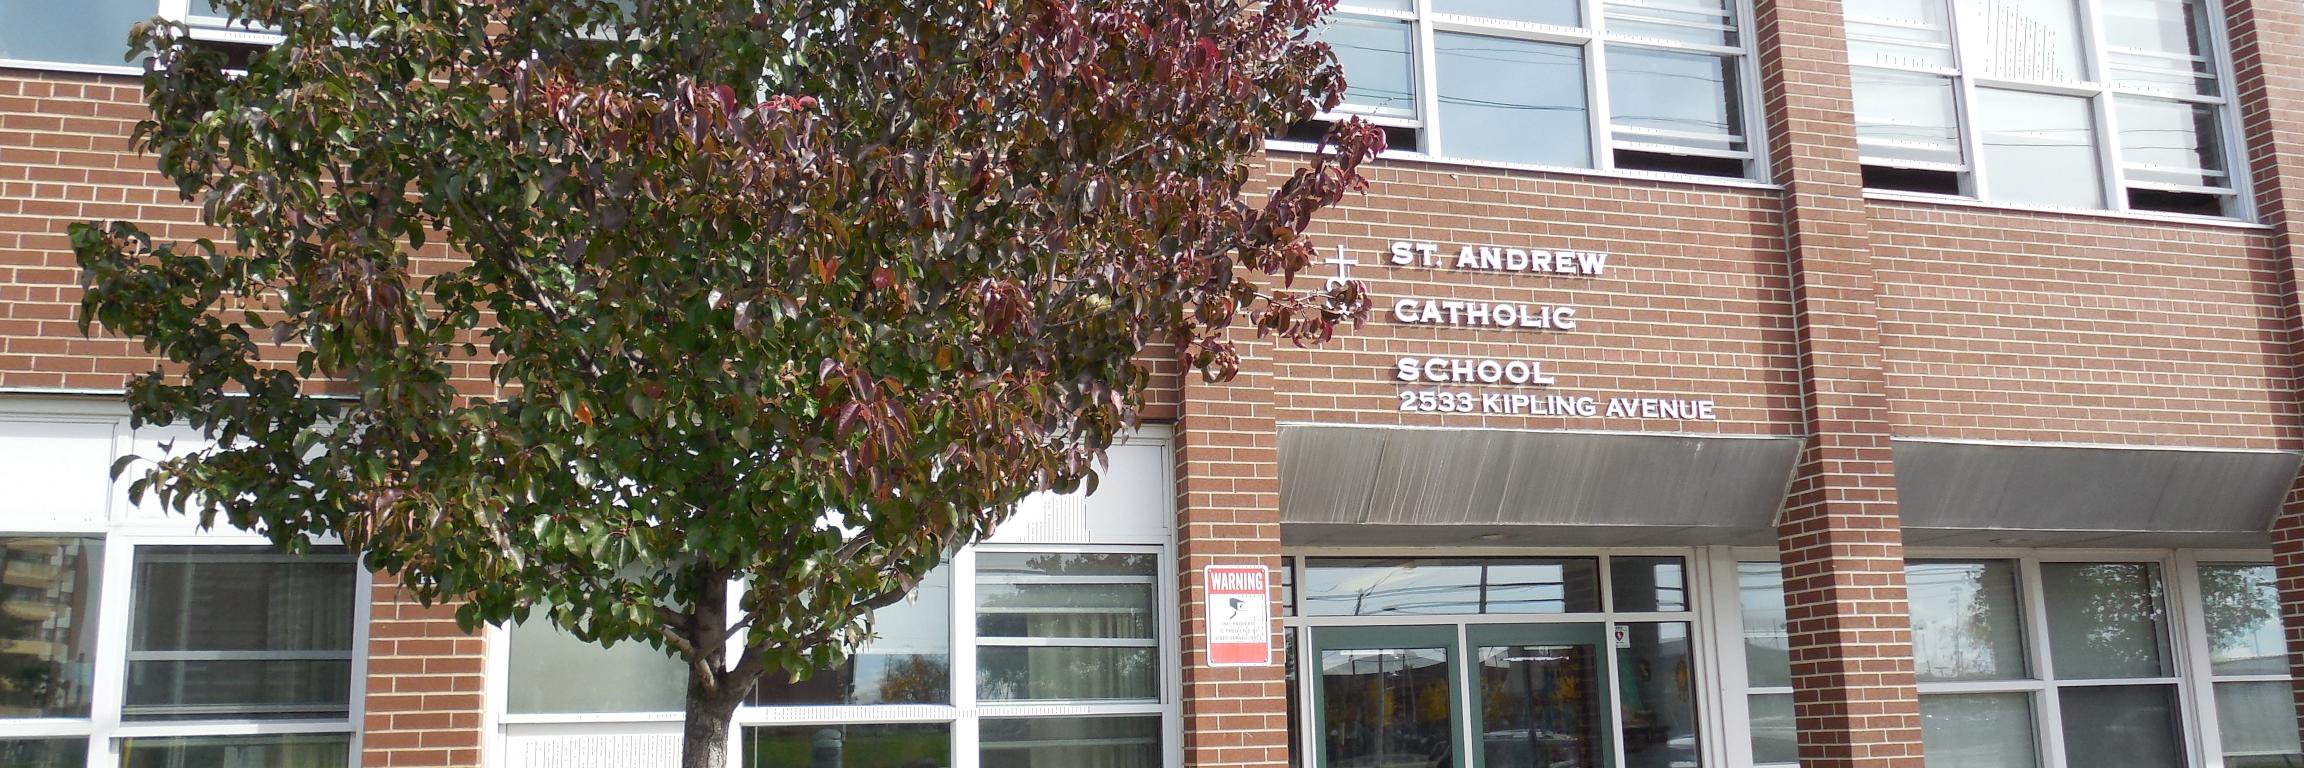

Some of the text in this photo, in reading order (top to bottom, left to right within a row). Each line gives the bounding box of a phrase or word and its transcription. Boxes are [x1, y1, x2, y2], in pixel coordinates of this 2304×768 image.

[1391, 242, 1608, 275] ST. ANDREW
[1394, 298, 1577, 330] CATHOLIC
[1397, 357, 1555, 386] SCHOOL
[1400, 390, 1717, 421] 2533 KIPLING AVENUE
[1211, 572, 1264, 592] WARNING
